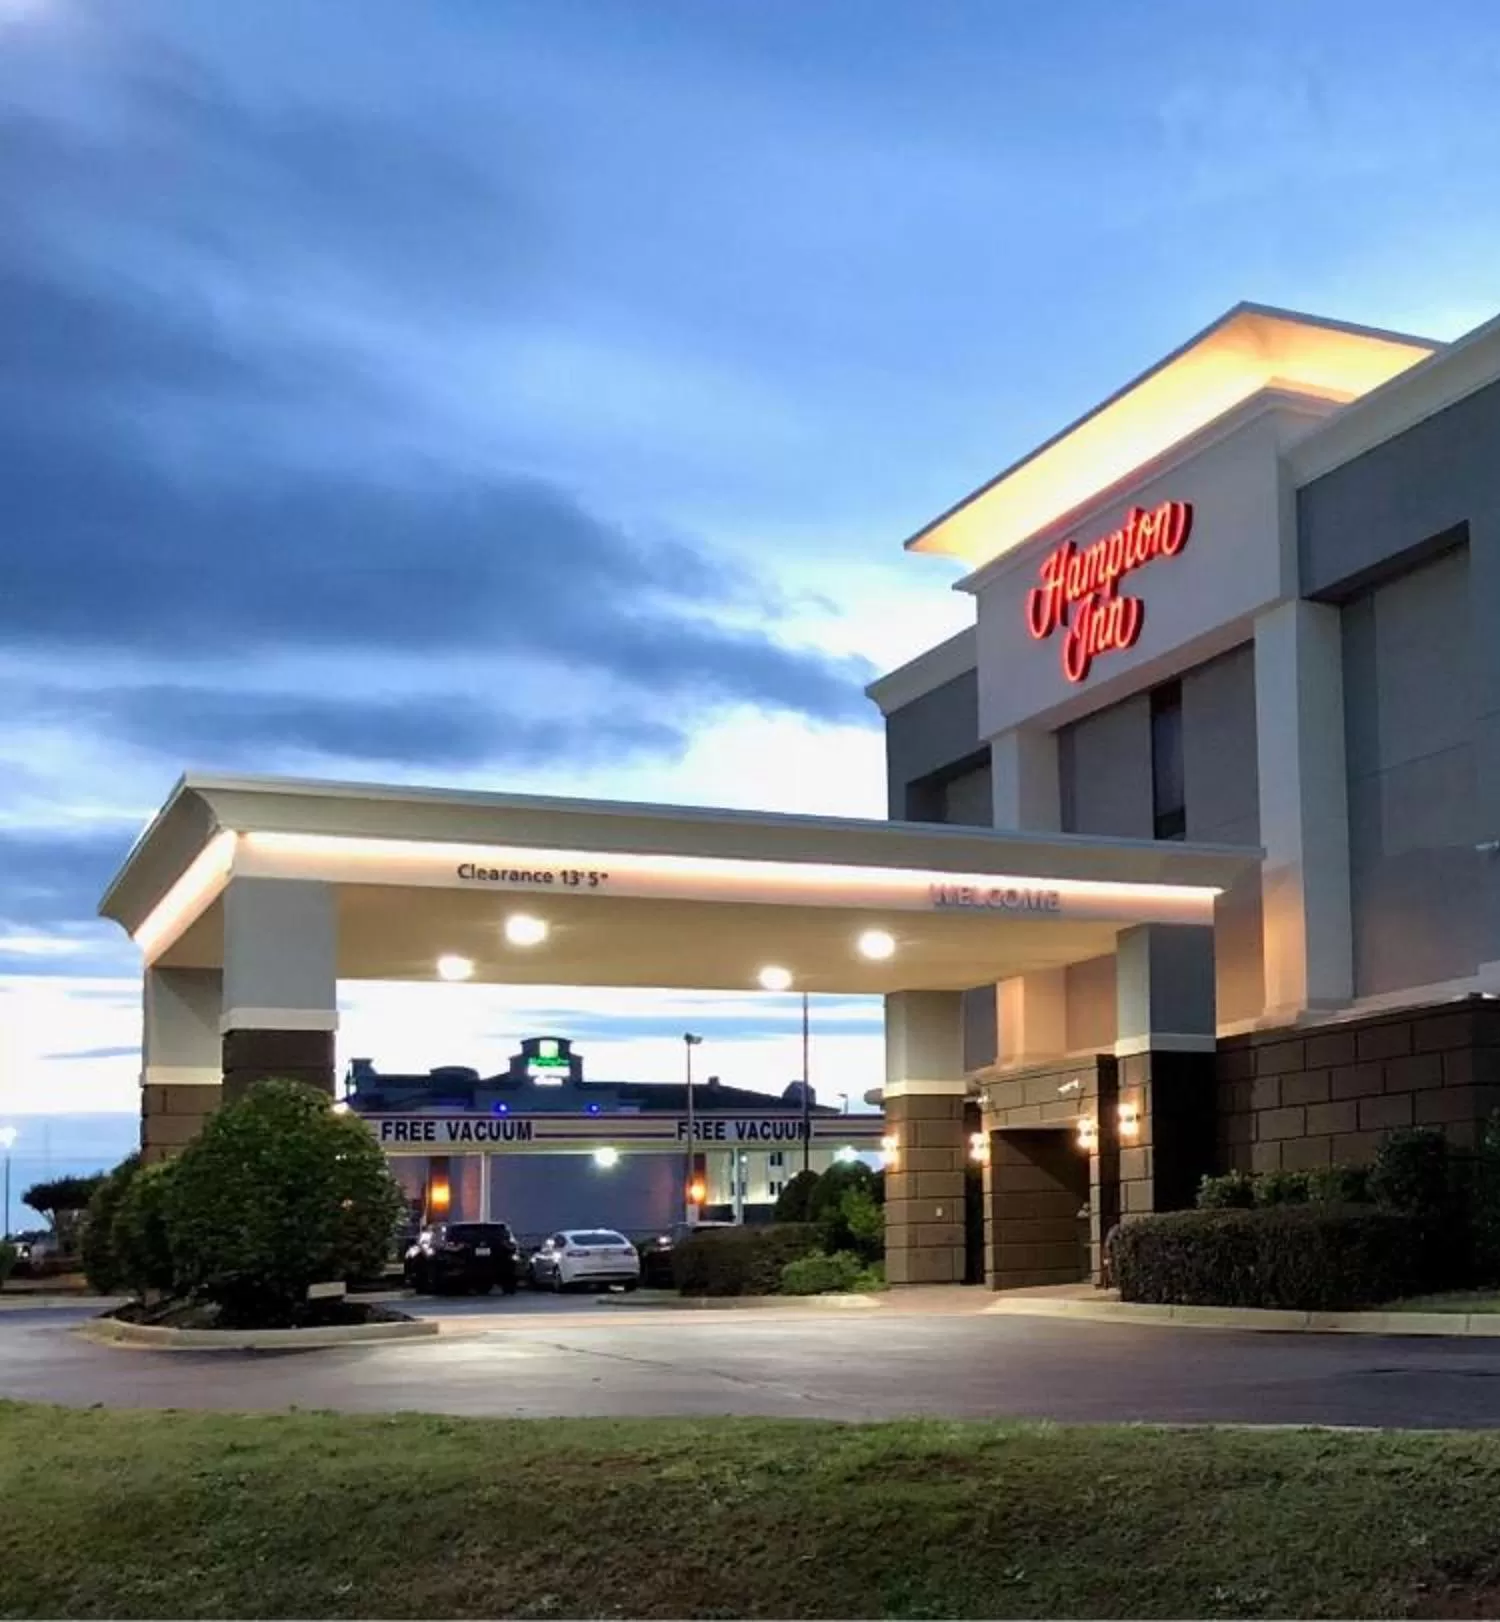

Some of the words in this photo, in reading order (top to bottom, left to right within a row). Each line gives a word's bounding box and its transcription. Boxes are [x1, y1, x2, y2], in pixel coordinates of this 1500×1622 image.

[1028, 501, 1193, 640] Hampton
[1063, 593, 1145, 683] Inn
[457, 863, 555, 884] Clearance
[929, 883, 1061, 912] WELCOME
[381, 1121, 435, 1141] FREE
[447, 1121, 533, 1141] VACUUM
[677, 1121, 725, 1141] FREE
